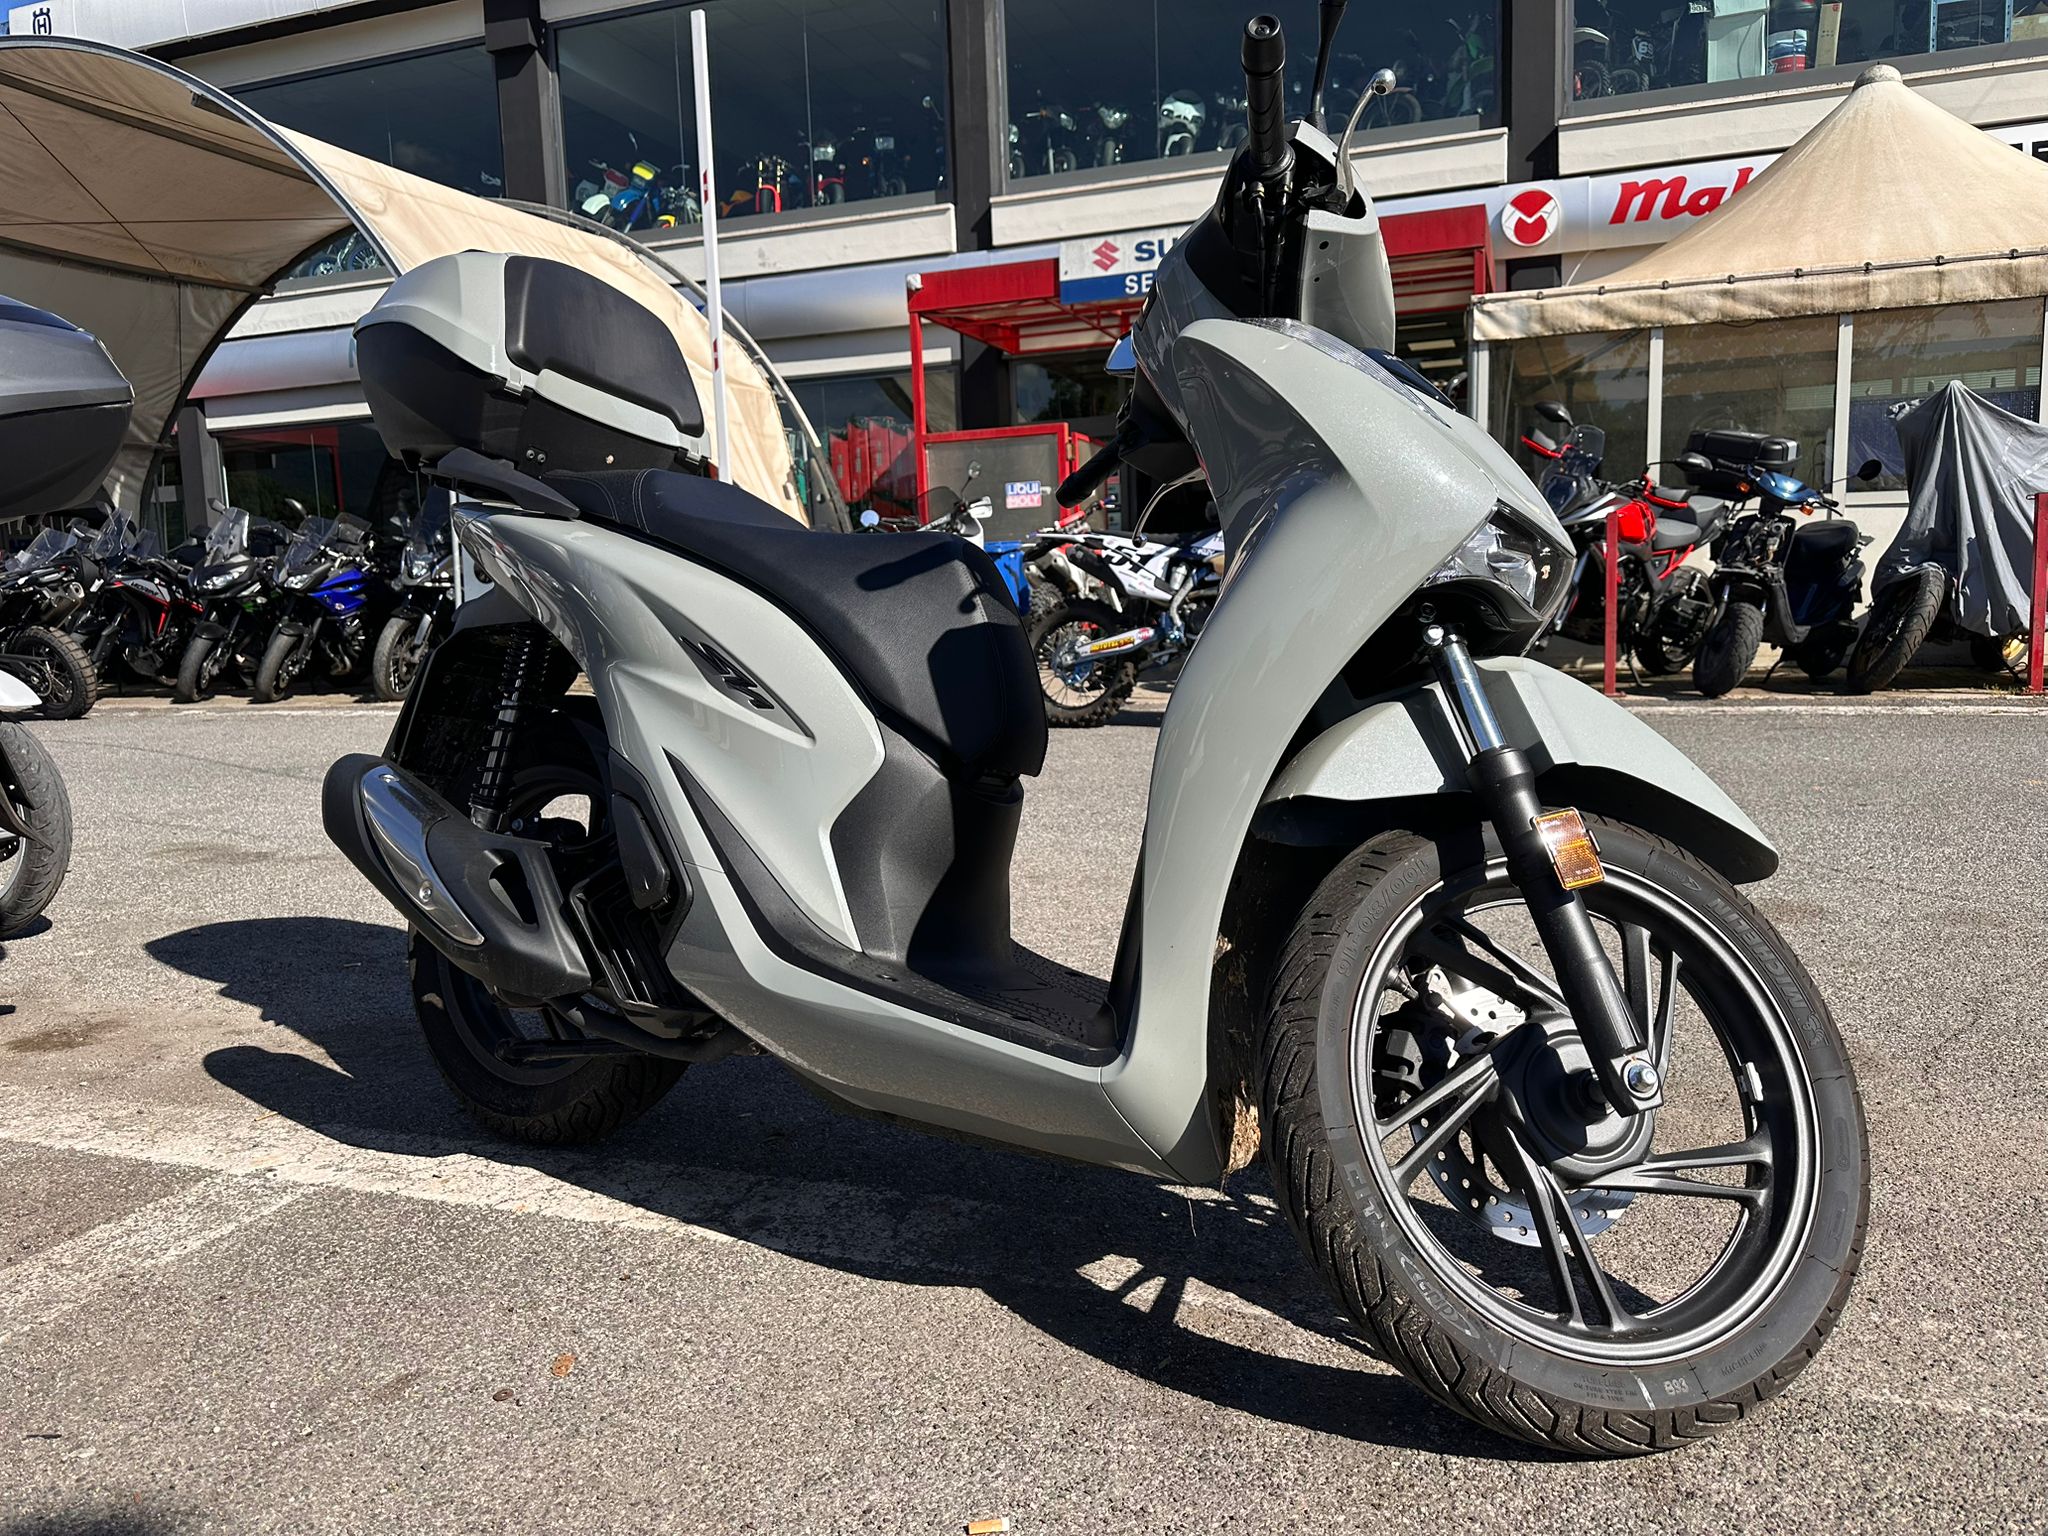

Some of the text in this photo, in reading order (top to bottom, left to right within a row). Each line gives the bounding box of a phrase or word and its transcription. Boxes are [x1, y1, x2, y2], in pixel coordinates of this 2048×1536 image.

[1006, 494, 1041, 508] MOLY
[1007, 482, 1040, 496] LIQUI
[1706, 897, 1808, 1009] MICHELIN
[1343, 1160, 1398, 1249] CITY
